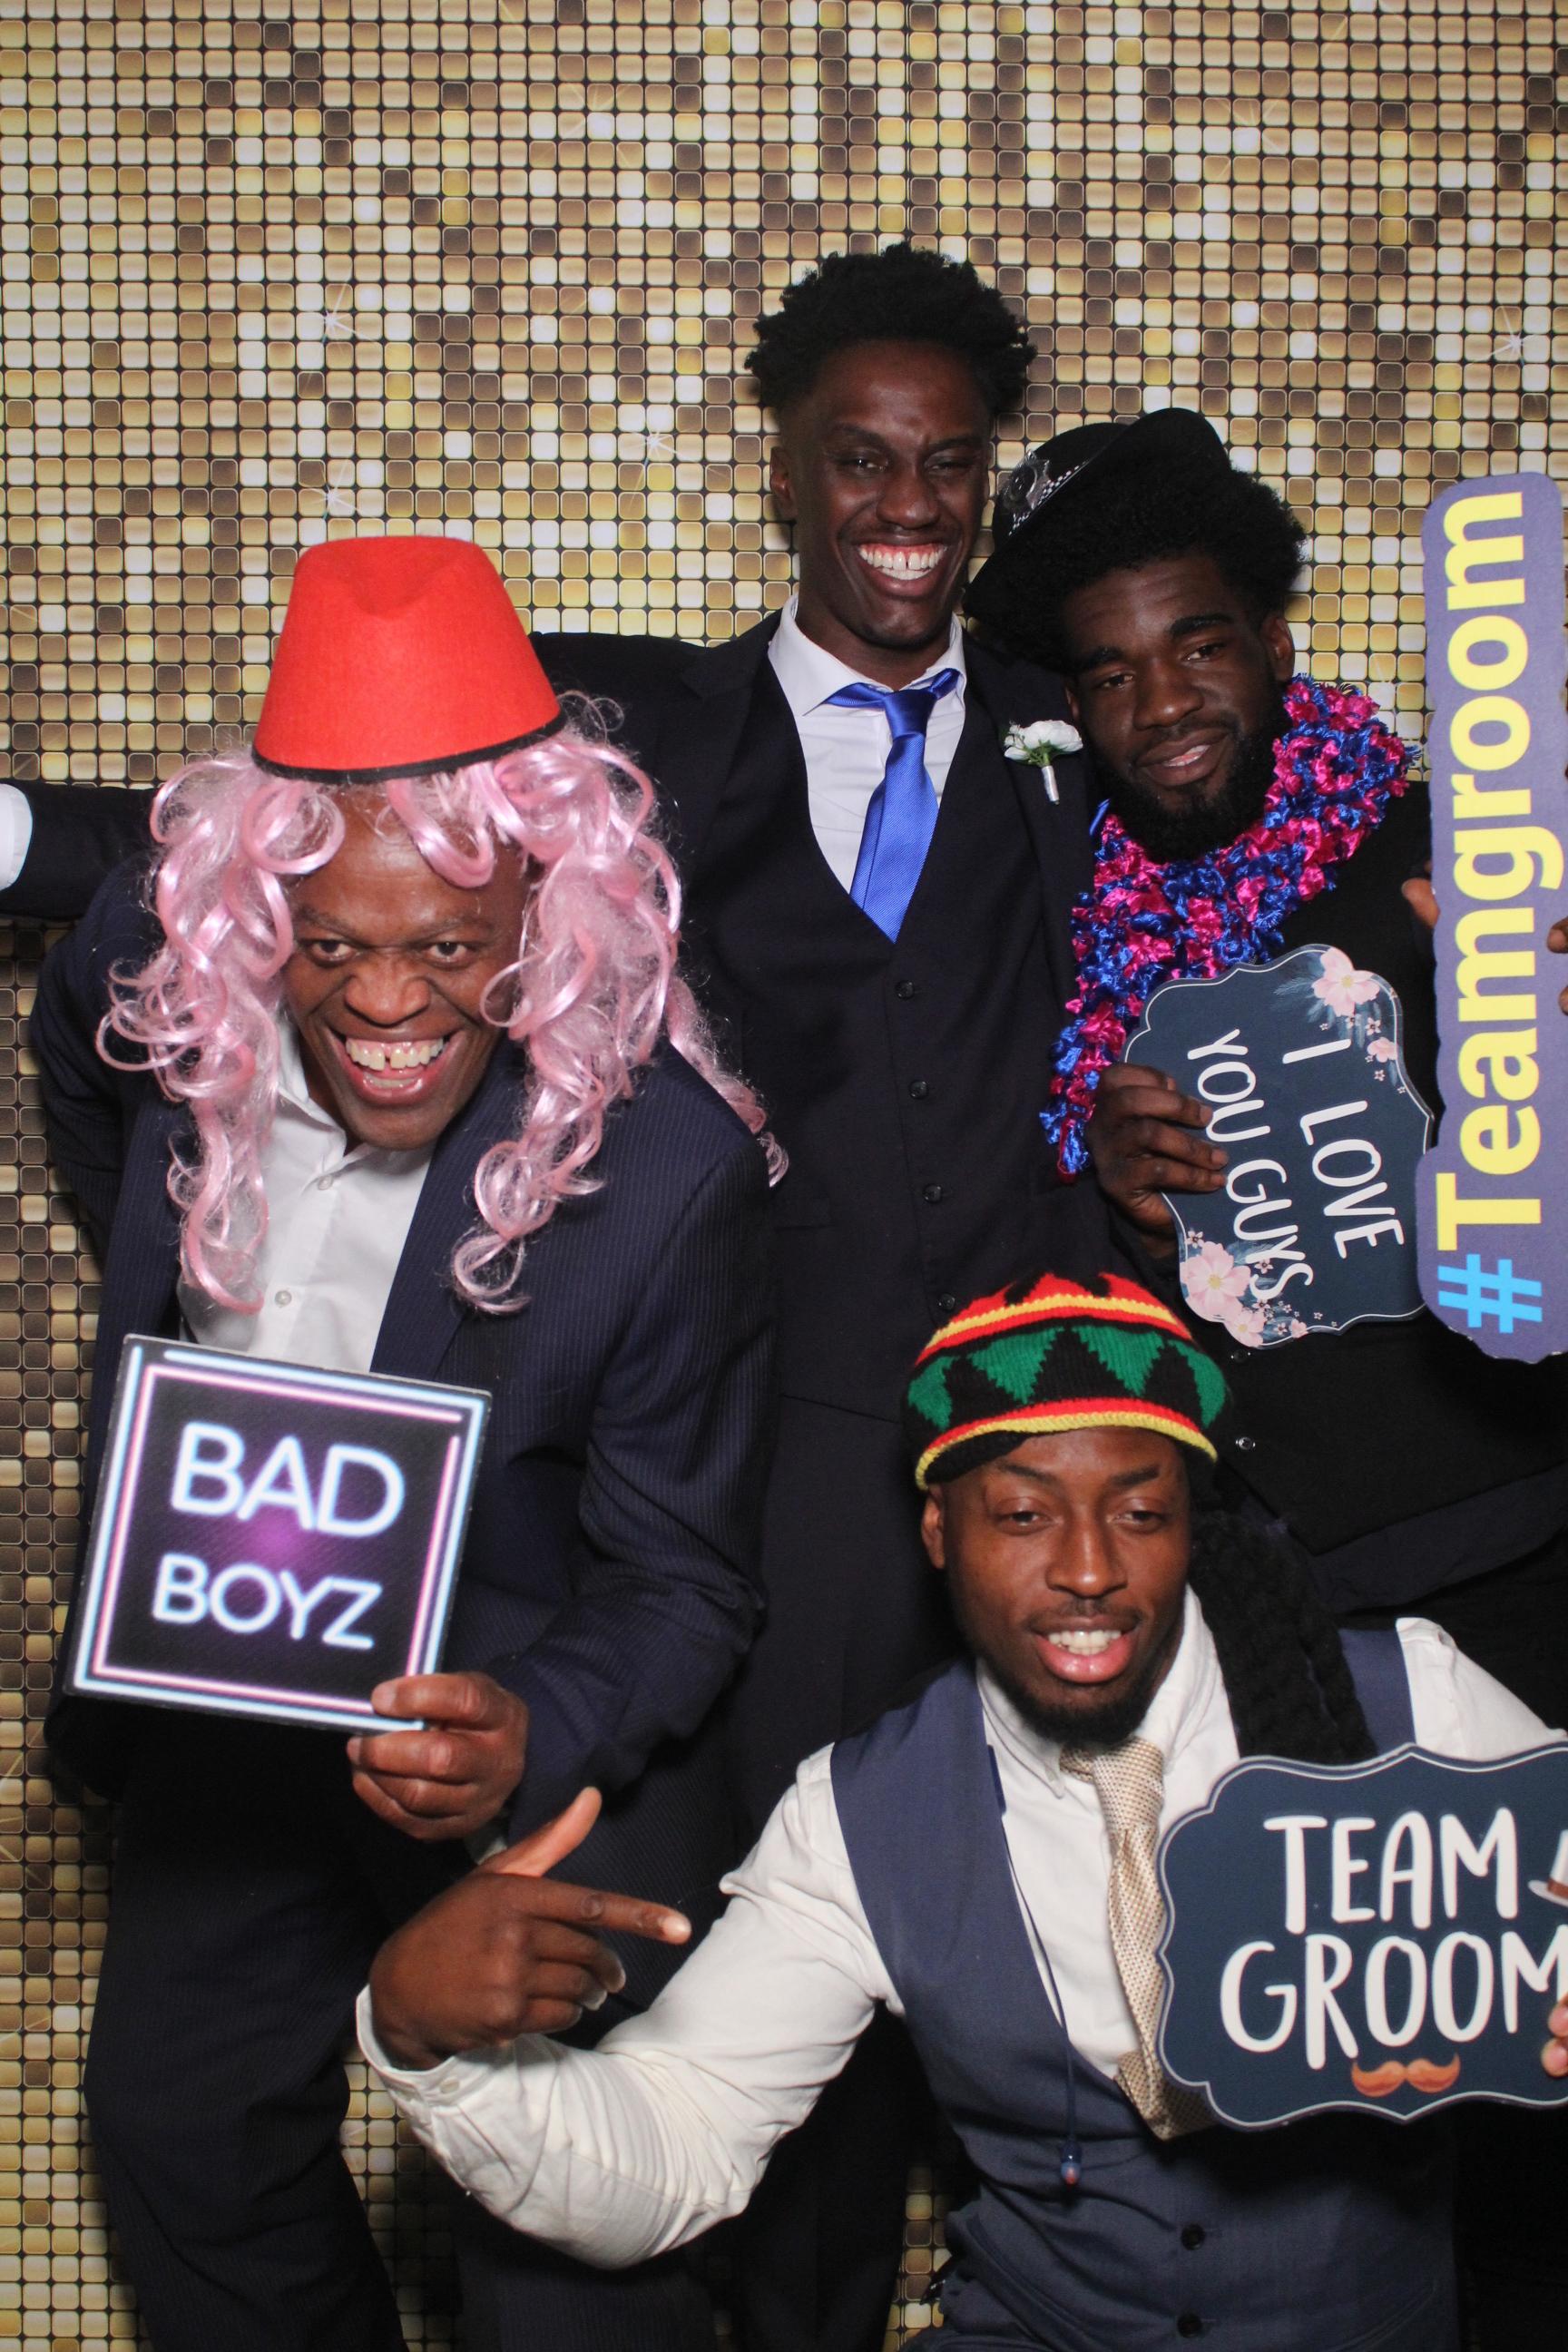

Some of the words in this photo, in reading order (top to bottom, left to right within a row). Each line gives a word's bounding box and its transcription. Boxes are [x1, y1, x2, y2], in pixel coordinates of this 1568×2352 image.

[1436, 491, 1563, 1334] #Teamgroom
[1187, 1028, 1271, 1142] YOU
[1282, 1038, 1352, 1064] I
[1225, 1159, 1314, 1300] GUYS
[1300, 1100, 1405, 1259] LOVE
[171, 1421, 405, 1538] BAD
[152, 1553, 383, 1651] BOYZ
[1263, 1807, 1518, 1935] TEAM
[1220, 1924, 1568, 2070] GROOM
